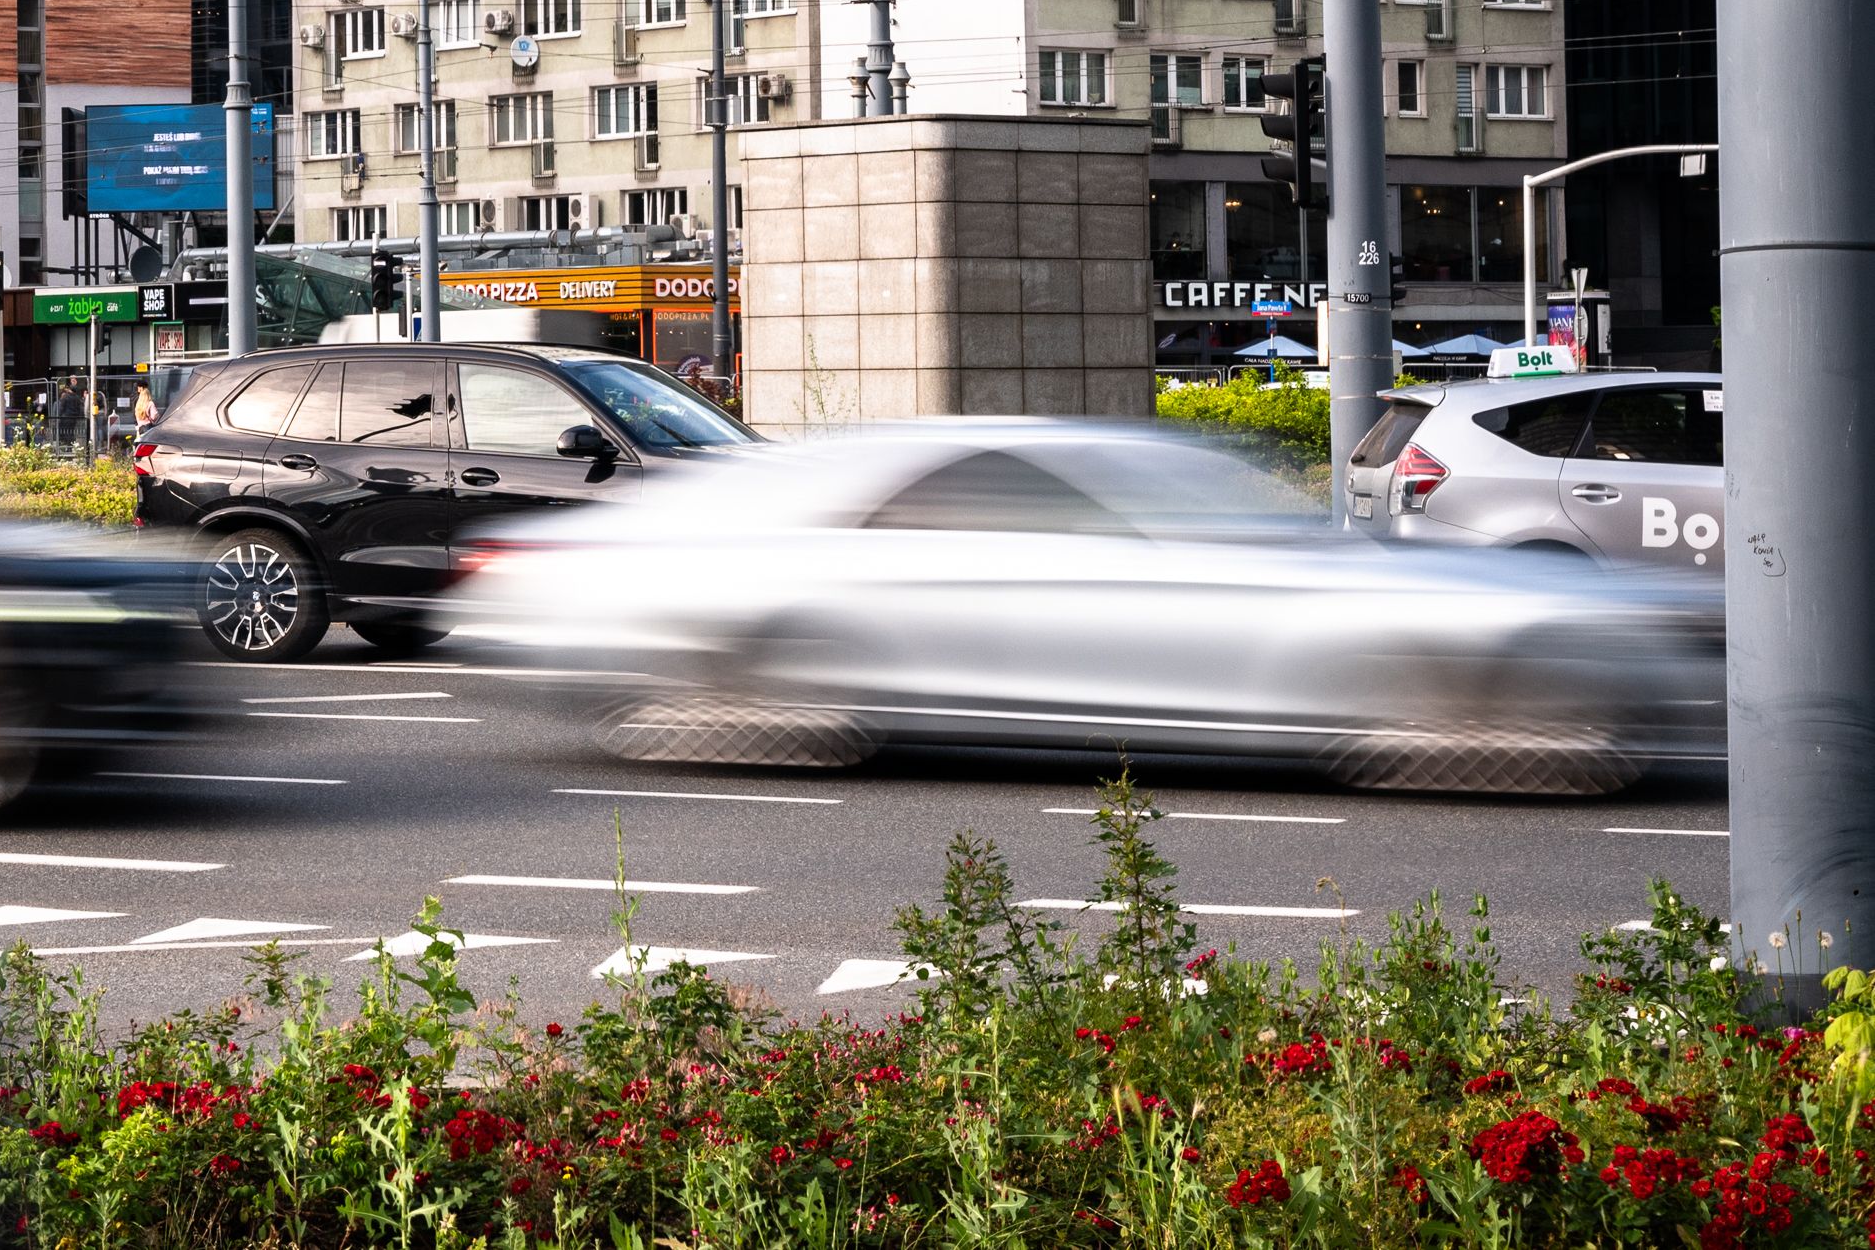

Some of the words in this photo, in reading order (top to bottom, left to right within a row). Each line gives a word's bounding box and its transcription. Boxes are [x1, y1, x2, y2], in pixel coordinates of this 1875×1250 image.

[1362, 240, 1376, 253] 16
[1358, 252, 1380, 266] 226
[143, 288, 165, 300] VAPE
[490, 282, 538, 302] PIZZA
[559, 280, 617, 300] DELIVERY
[654, 277, 714, 298] DODO
[1166, 282, 1272, 307] CAFFE
[68, 297, 103, 315] żabka
[143, 300, 166, 312] SHOP
[1346, 293, 1370, 303] 15700
[1518, 350, 1553, 369] Bolt
[1642, 496, 1724, 563] Bo
